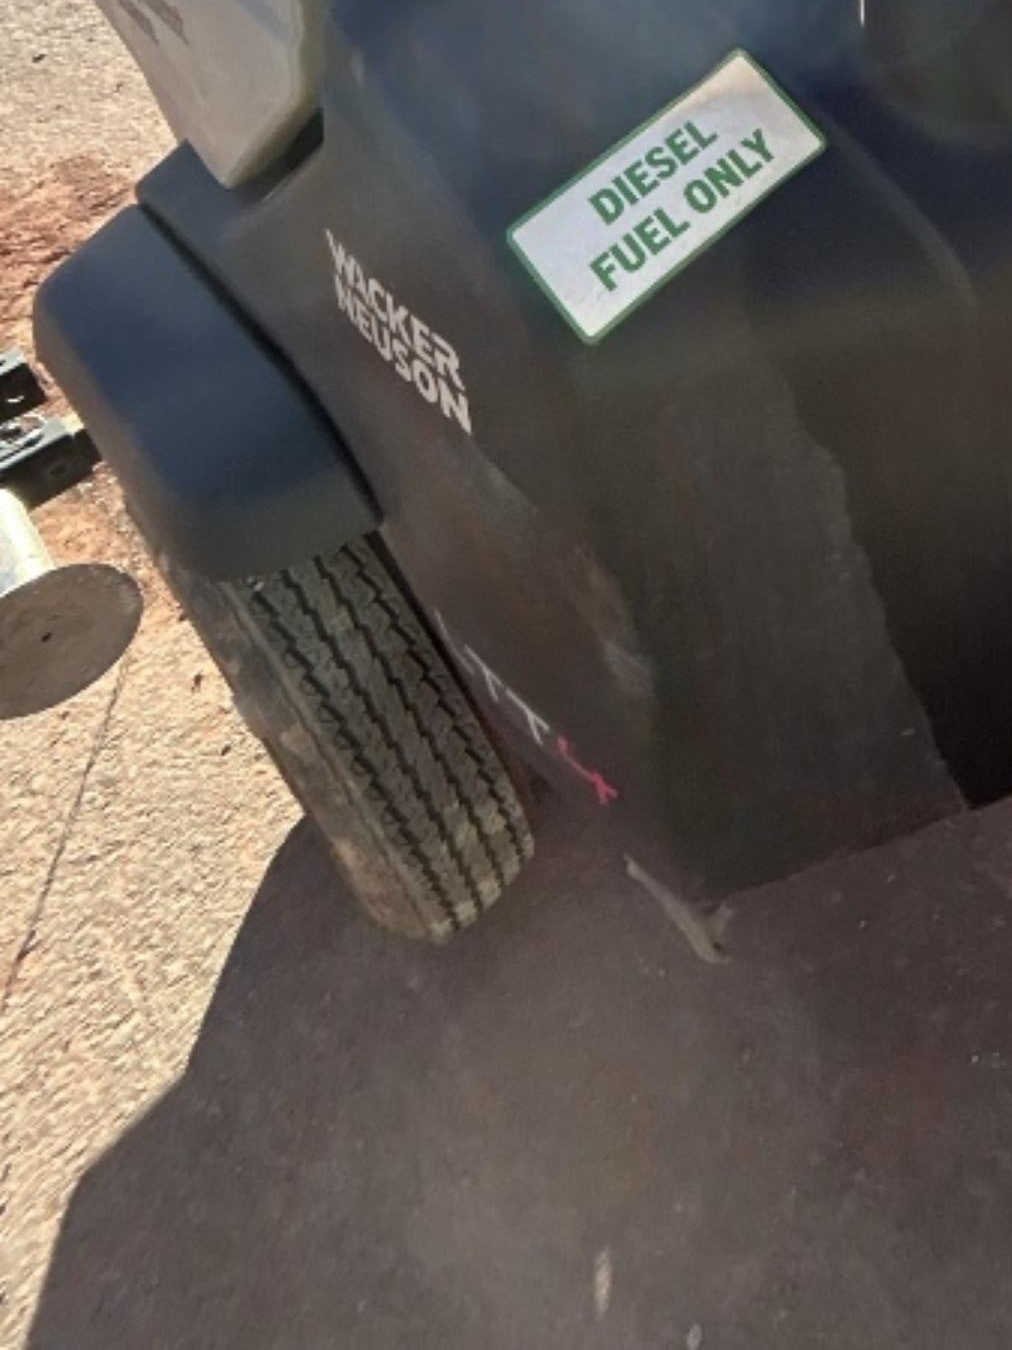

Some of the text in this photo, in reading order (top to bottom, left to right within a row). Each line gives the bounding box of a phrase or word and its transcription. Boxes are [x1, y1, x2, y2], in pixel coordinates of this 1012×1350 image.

[588, 120, 718, 226] DIESEL
[589, 128, 775, 292] FUEL ONLY
[324, 227, 465, 392] WACKER
[335, 272, 472, 435] NEUSON
